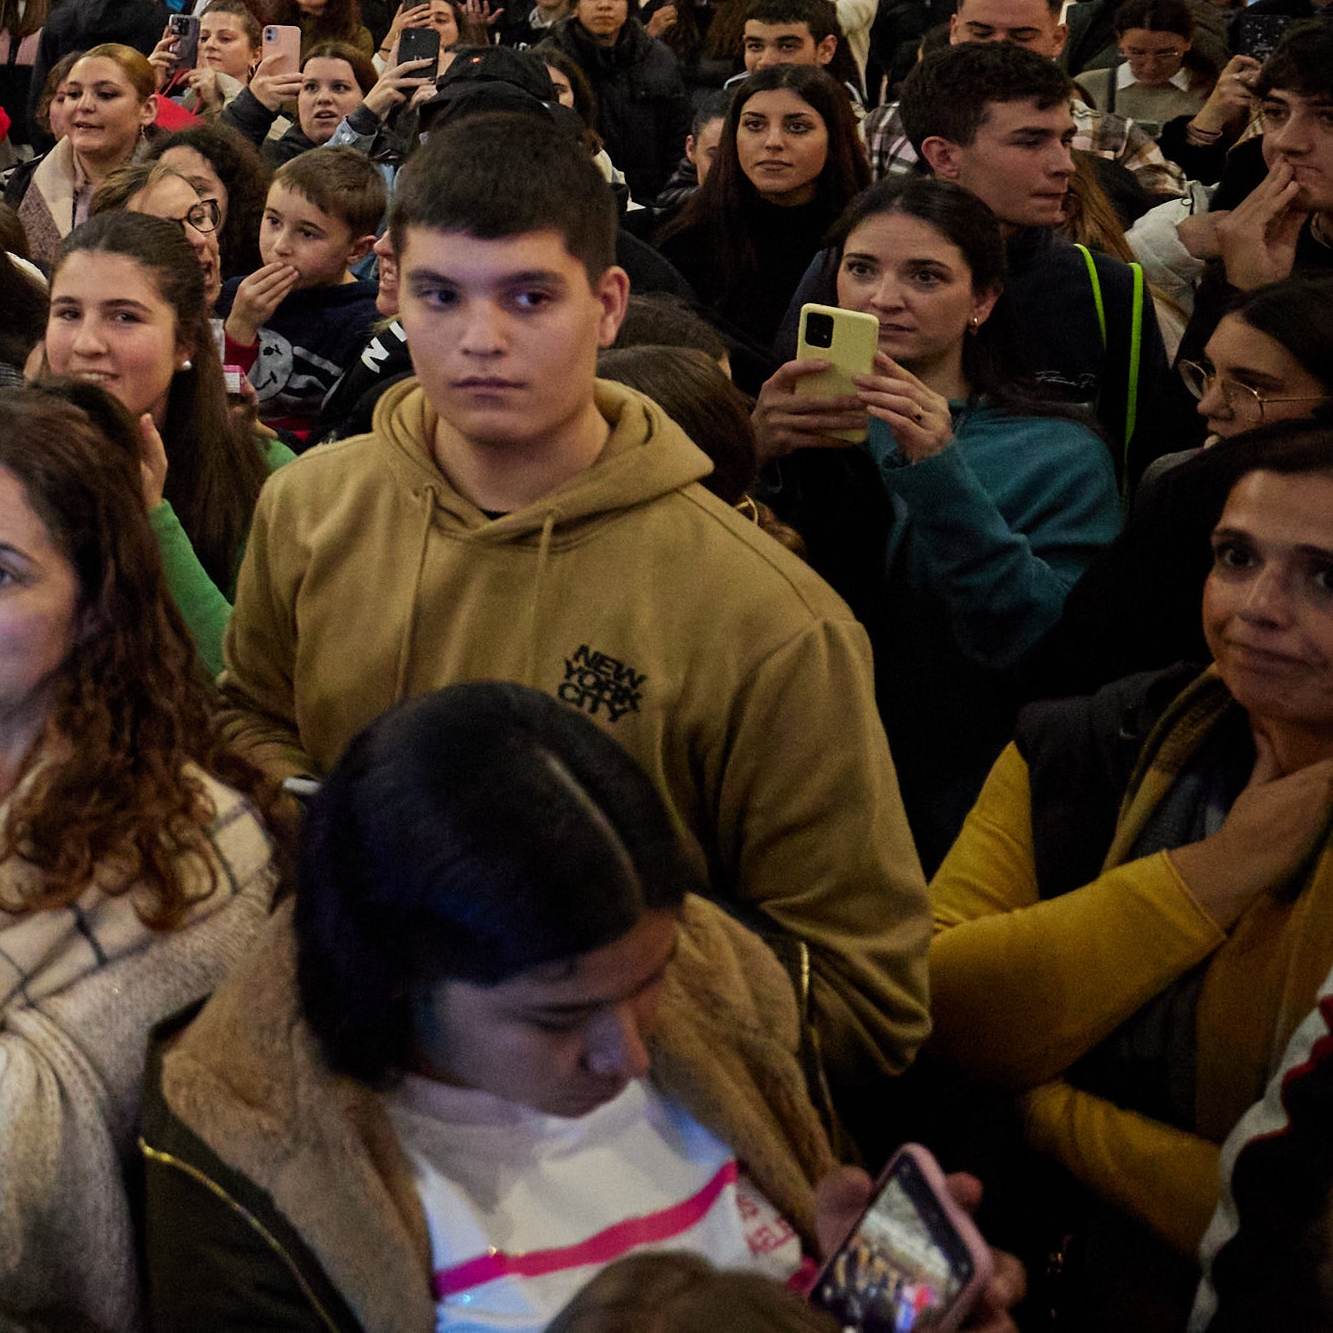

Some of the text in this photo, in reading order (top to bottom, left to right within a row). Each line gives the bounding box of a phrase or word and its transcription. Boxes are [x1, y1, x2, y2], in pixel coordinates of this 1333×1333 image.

[563, 657, 643, 714] YORK
[573, 643, 647, 690] NEW
[557, 681, 629, 724] CITY
